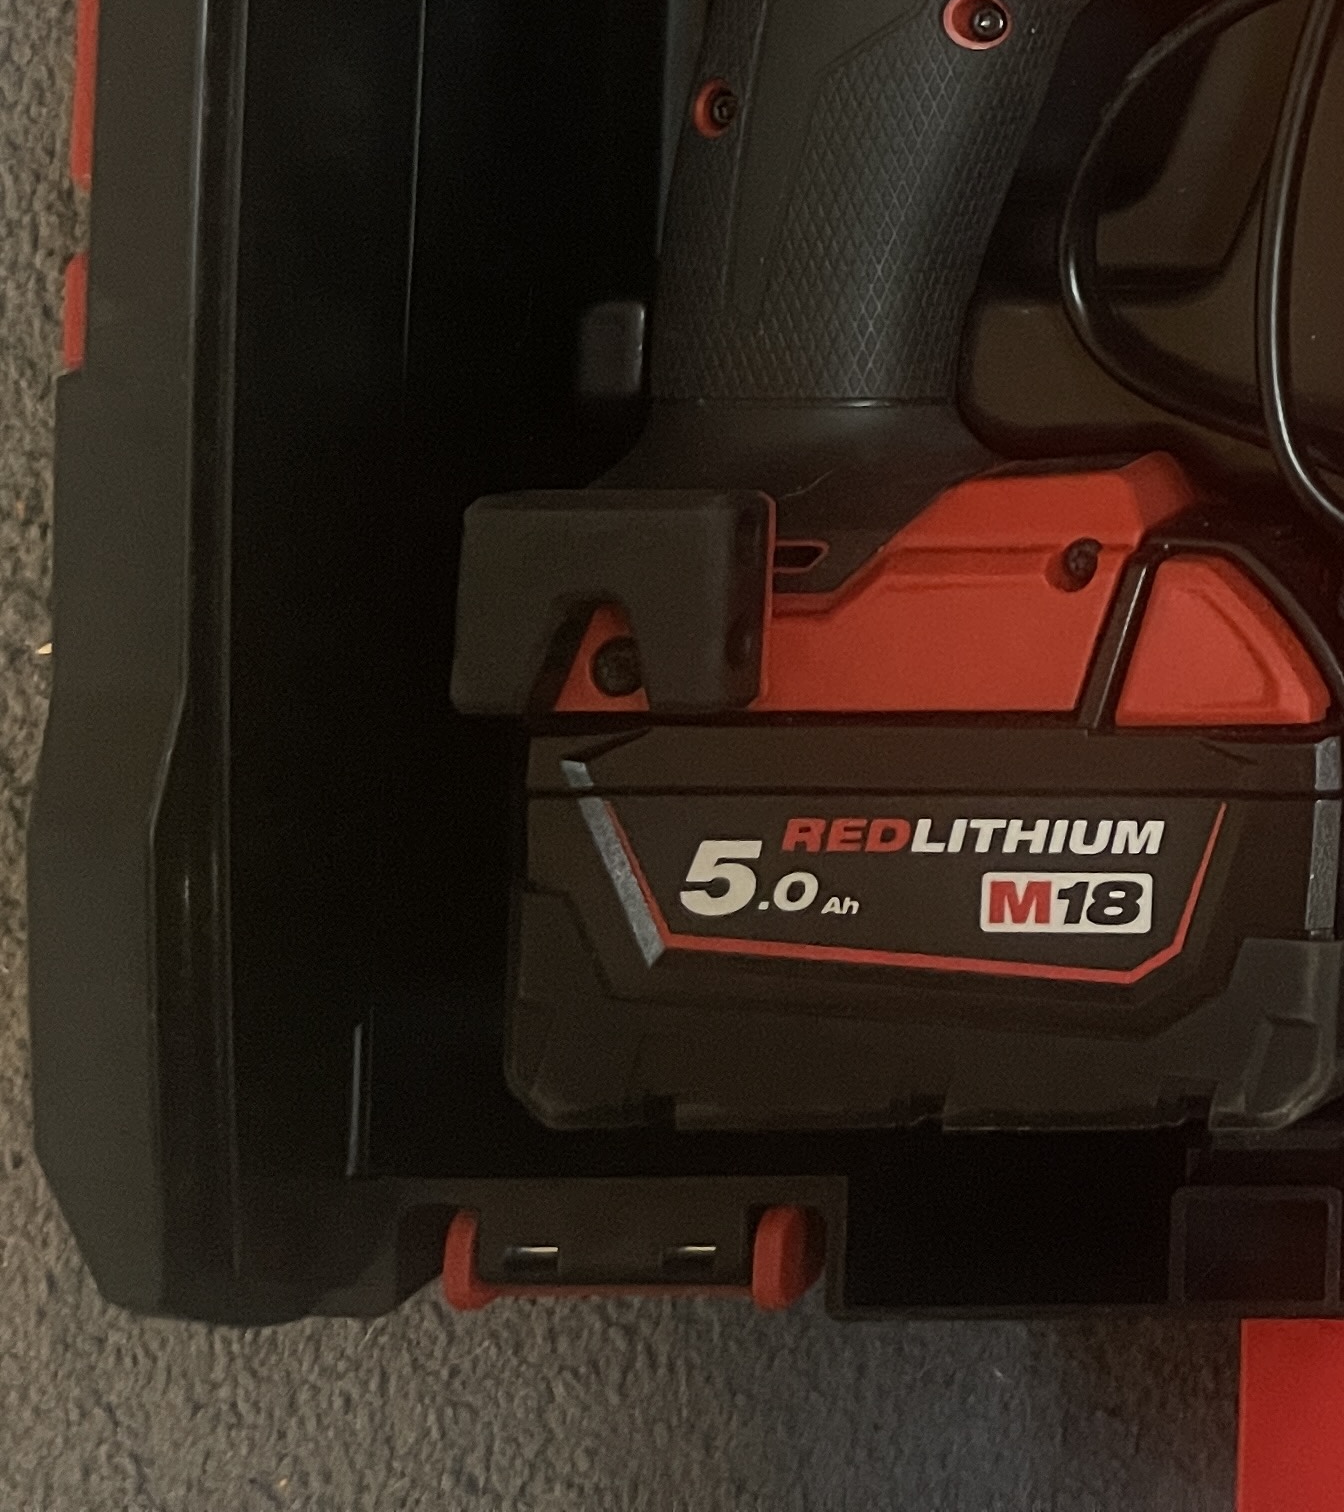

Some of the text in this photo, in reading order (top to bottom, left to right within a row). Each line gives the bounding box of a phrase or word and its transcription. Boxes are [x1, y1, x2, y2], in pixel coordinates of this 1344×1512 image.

[780, 816, 1166, 856] REDLITHIUM
[679, 839, 861, 917] 5.0 Ah
[987, 880, 1144, 926] M18
